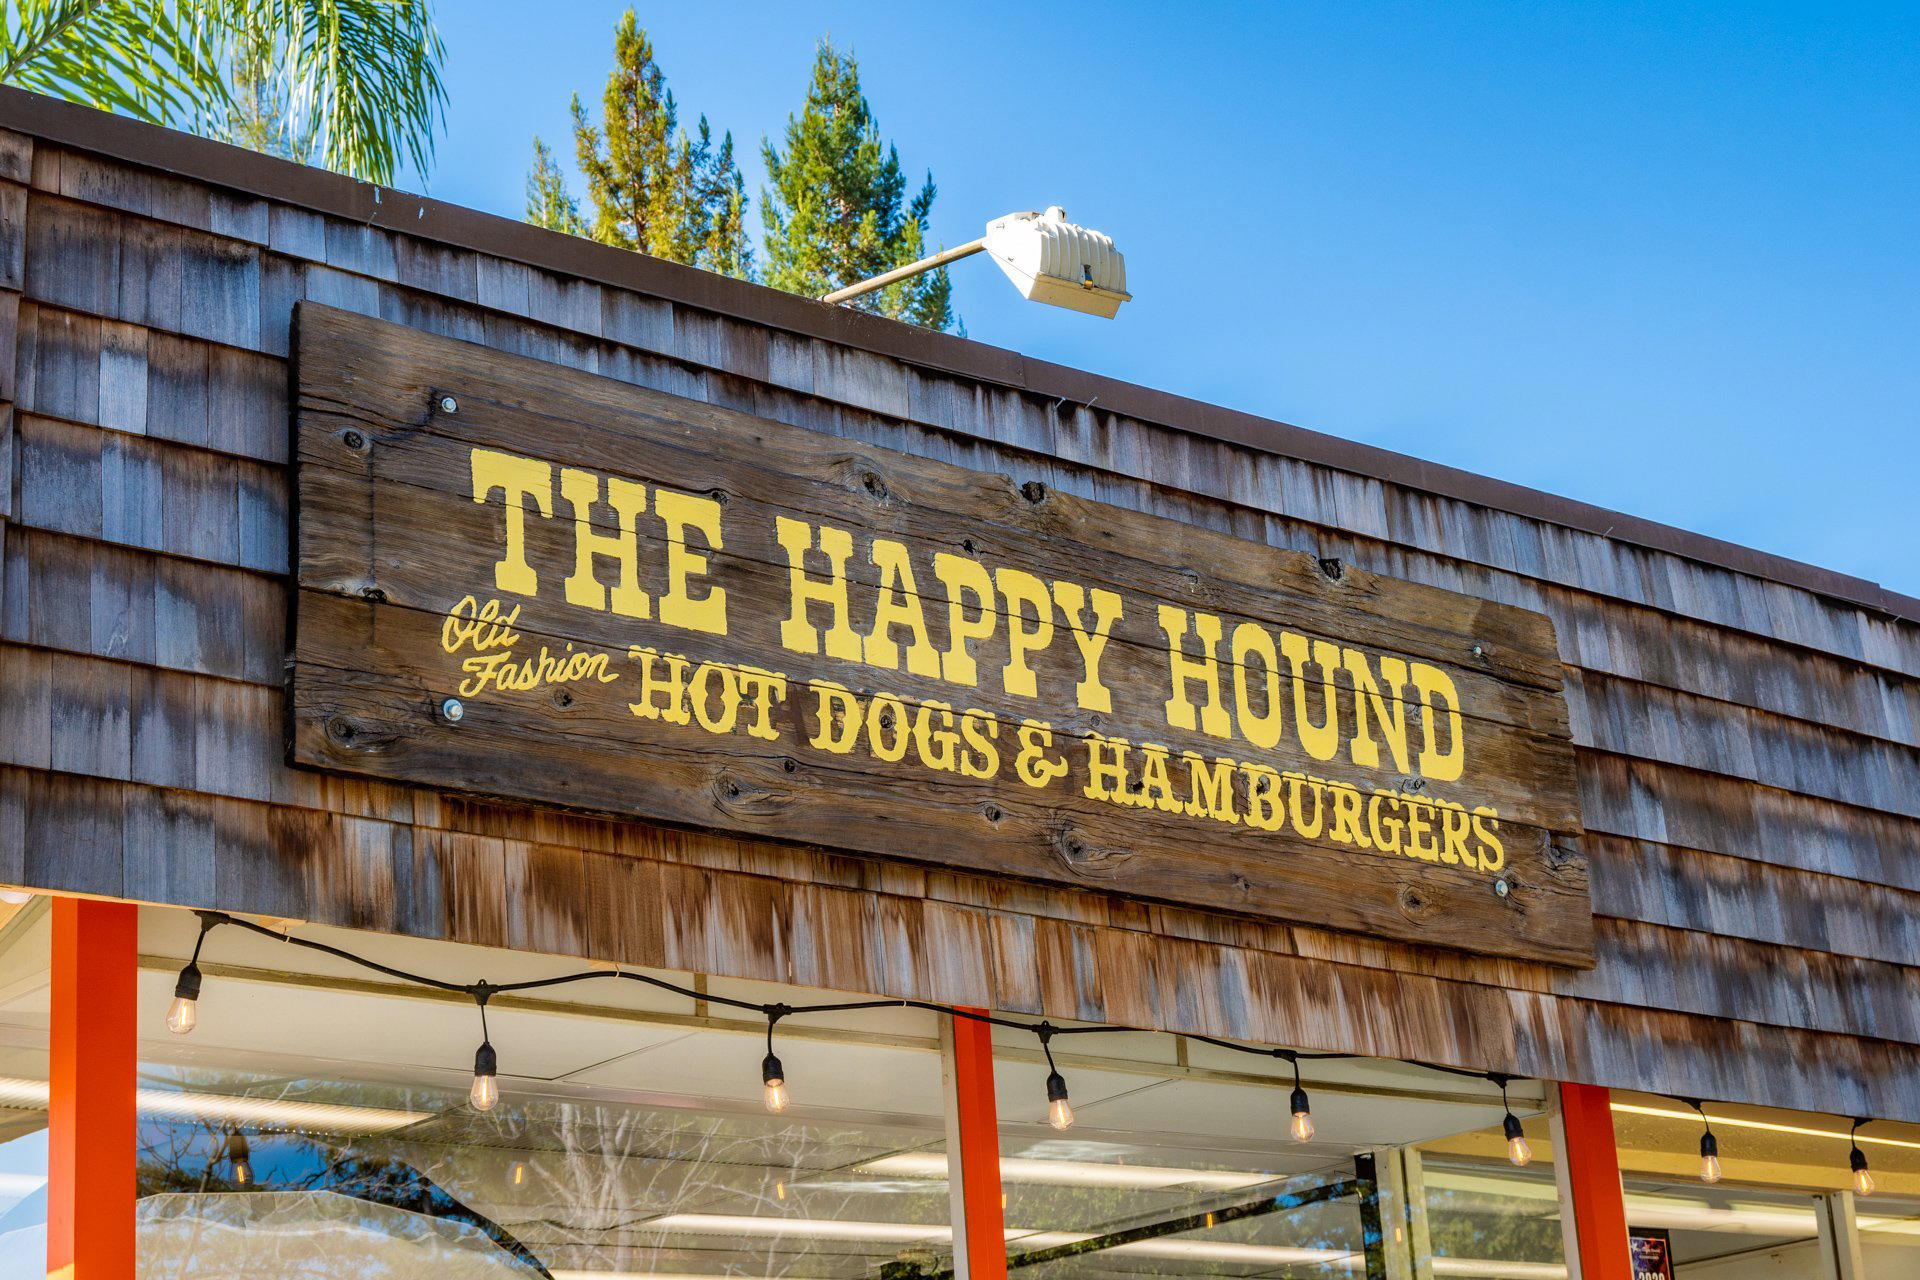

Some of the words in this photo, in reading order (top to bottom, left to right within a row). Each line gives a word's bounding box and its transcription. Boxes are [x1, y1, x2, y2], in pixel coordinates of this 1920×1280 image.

[441, 594, 521, 654] Old
[459, 642, 620, 698] Fashion
[471, 447, 728, 636] THE
[776, 515, 1124, 714] HAPPY
[1158, 604, 1465, 783] HOUND
[628, 645, 787, 741] HOT
[809, 679, 1000, 781] DOGS
[1015, 718, 1069, 789] &
[1082, 730, 1505, 872] HAMBURGERS
